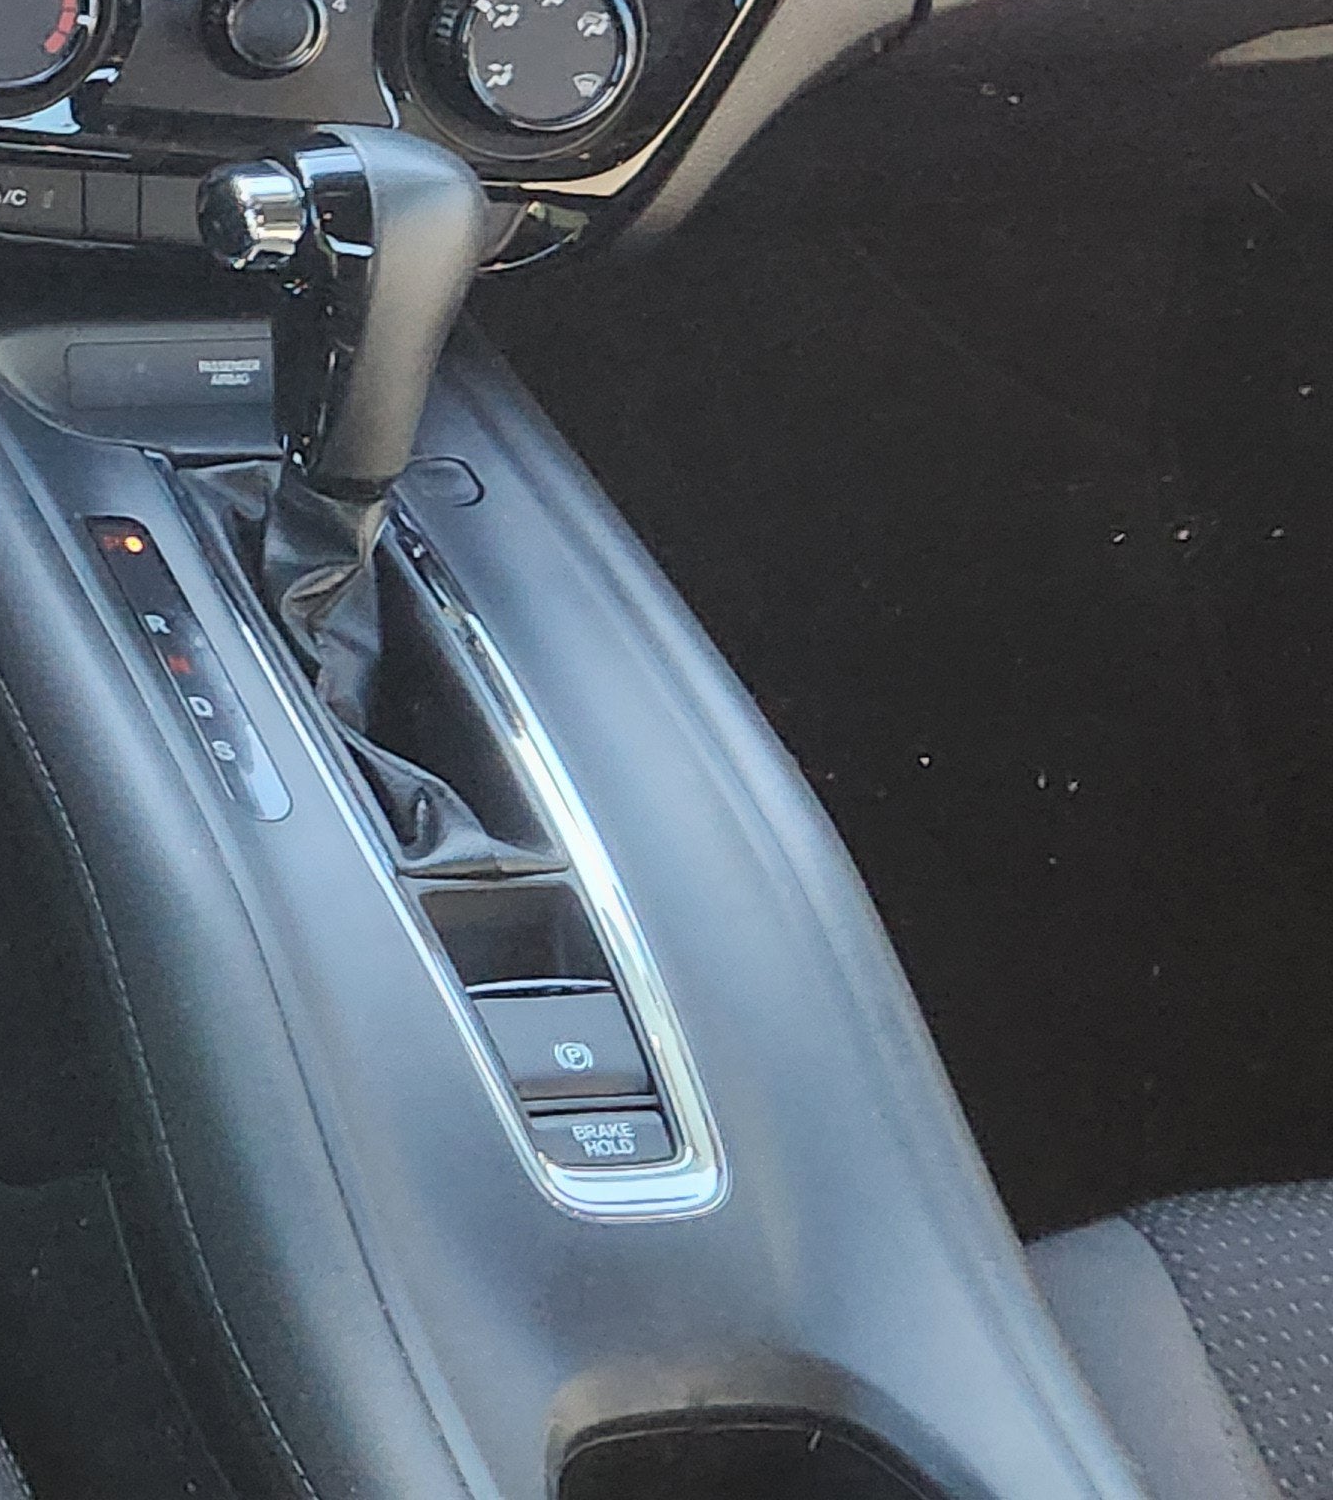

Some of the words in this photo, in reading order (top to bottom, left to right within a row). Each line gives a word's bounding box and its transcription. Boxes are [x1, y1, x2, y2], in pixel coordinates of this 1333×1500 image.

[144, 613, 172, 635] R
[187, 695, 214, 719] D
[571, 1121, 635, 1142] BRAKE
[582, 1138, 635, 1157] HOLD
